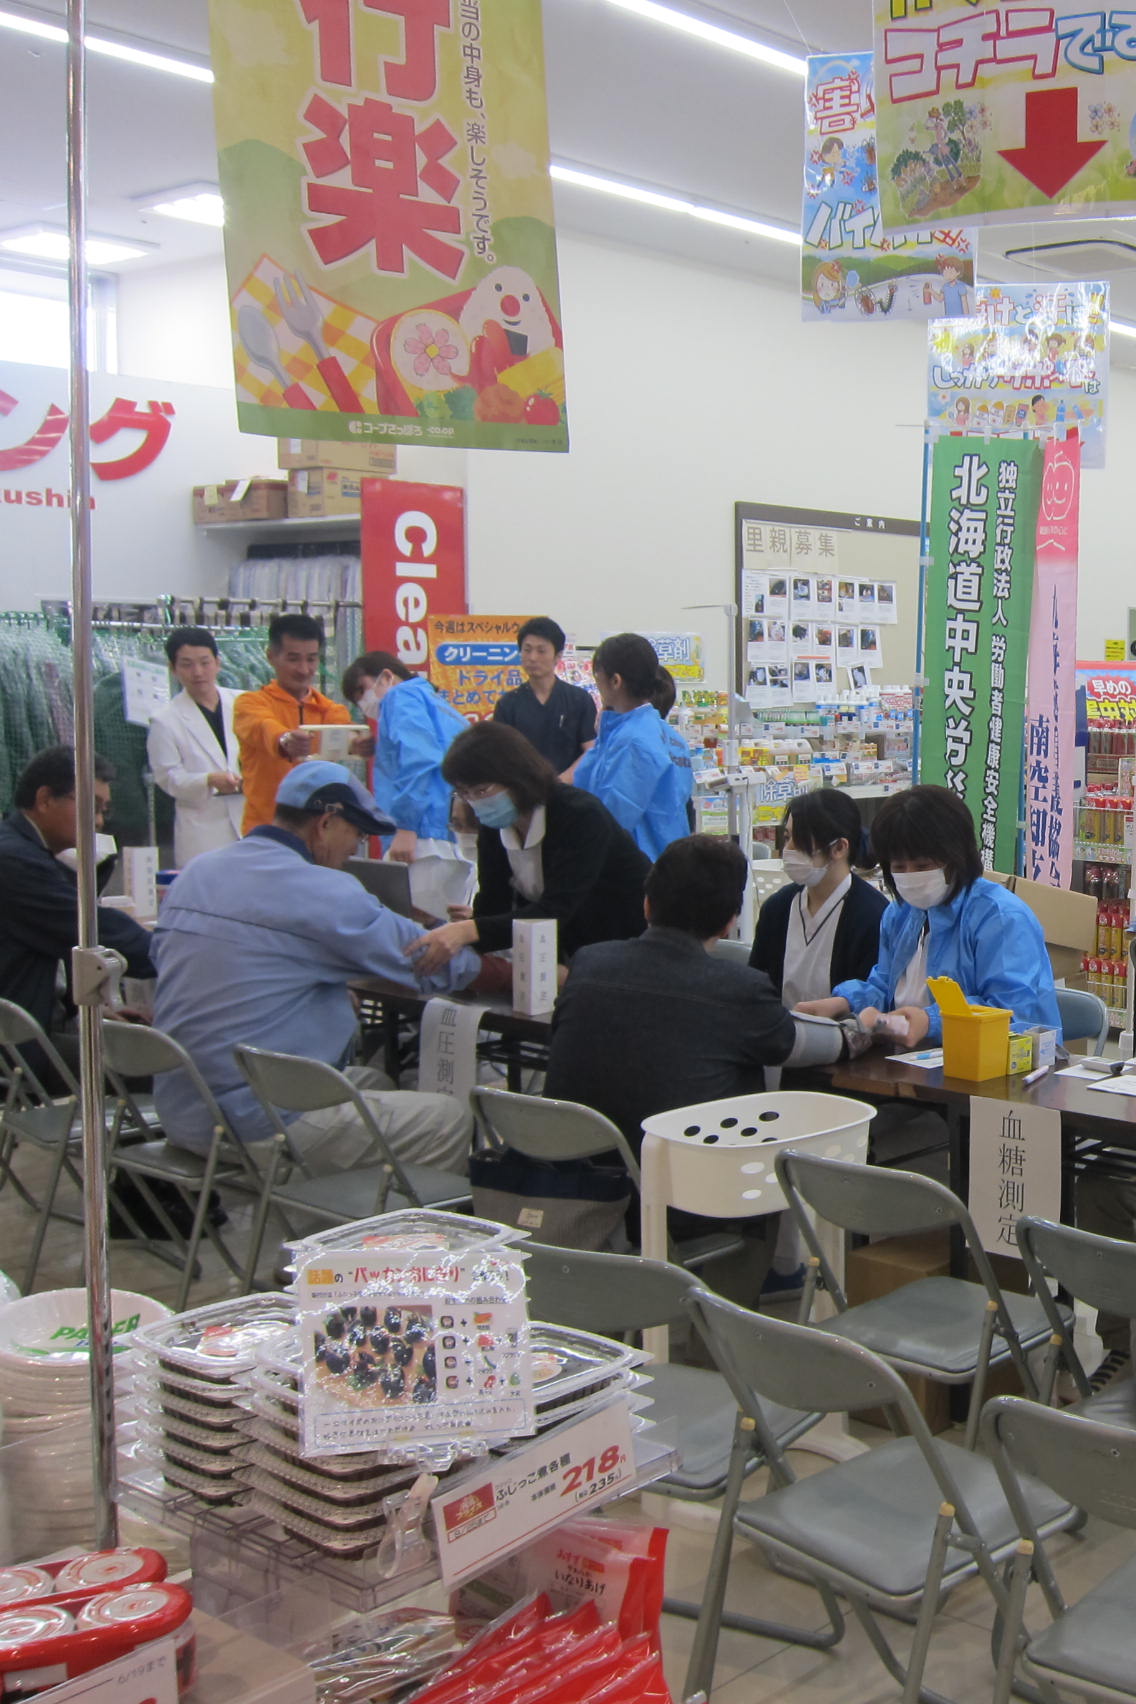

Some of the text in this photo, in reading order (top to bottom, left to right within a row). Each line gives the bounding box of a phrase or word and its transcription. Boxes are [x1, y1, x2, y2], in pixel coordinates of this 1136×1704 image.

[745, 526, 836, 557] 里親募集
[991, 460, 1020, 627] 独立行政法人
[394, 510, 438, 680] Clea
[444, 648, 522, 663] クリーニン
[1092, 679, 1132, 696] 早めの
[997, 1109, 1027, 1248] 血糖測定
